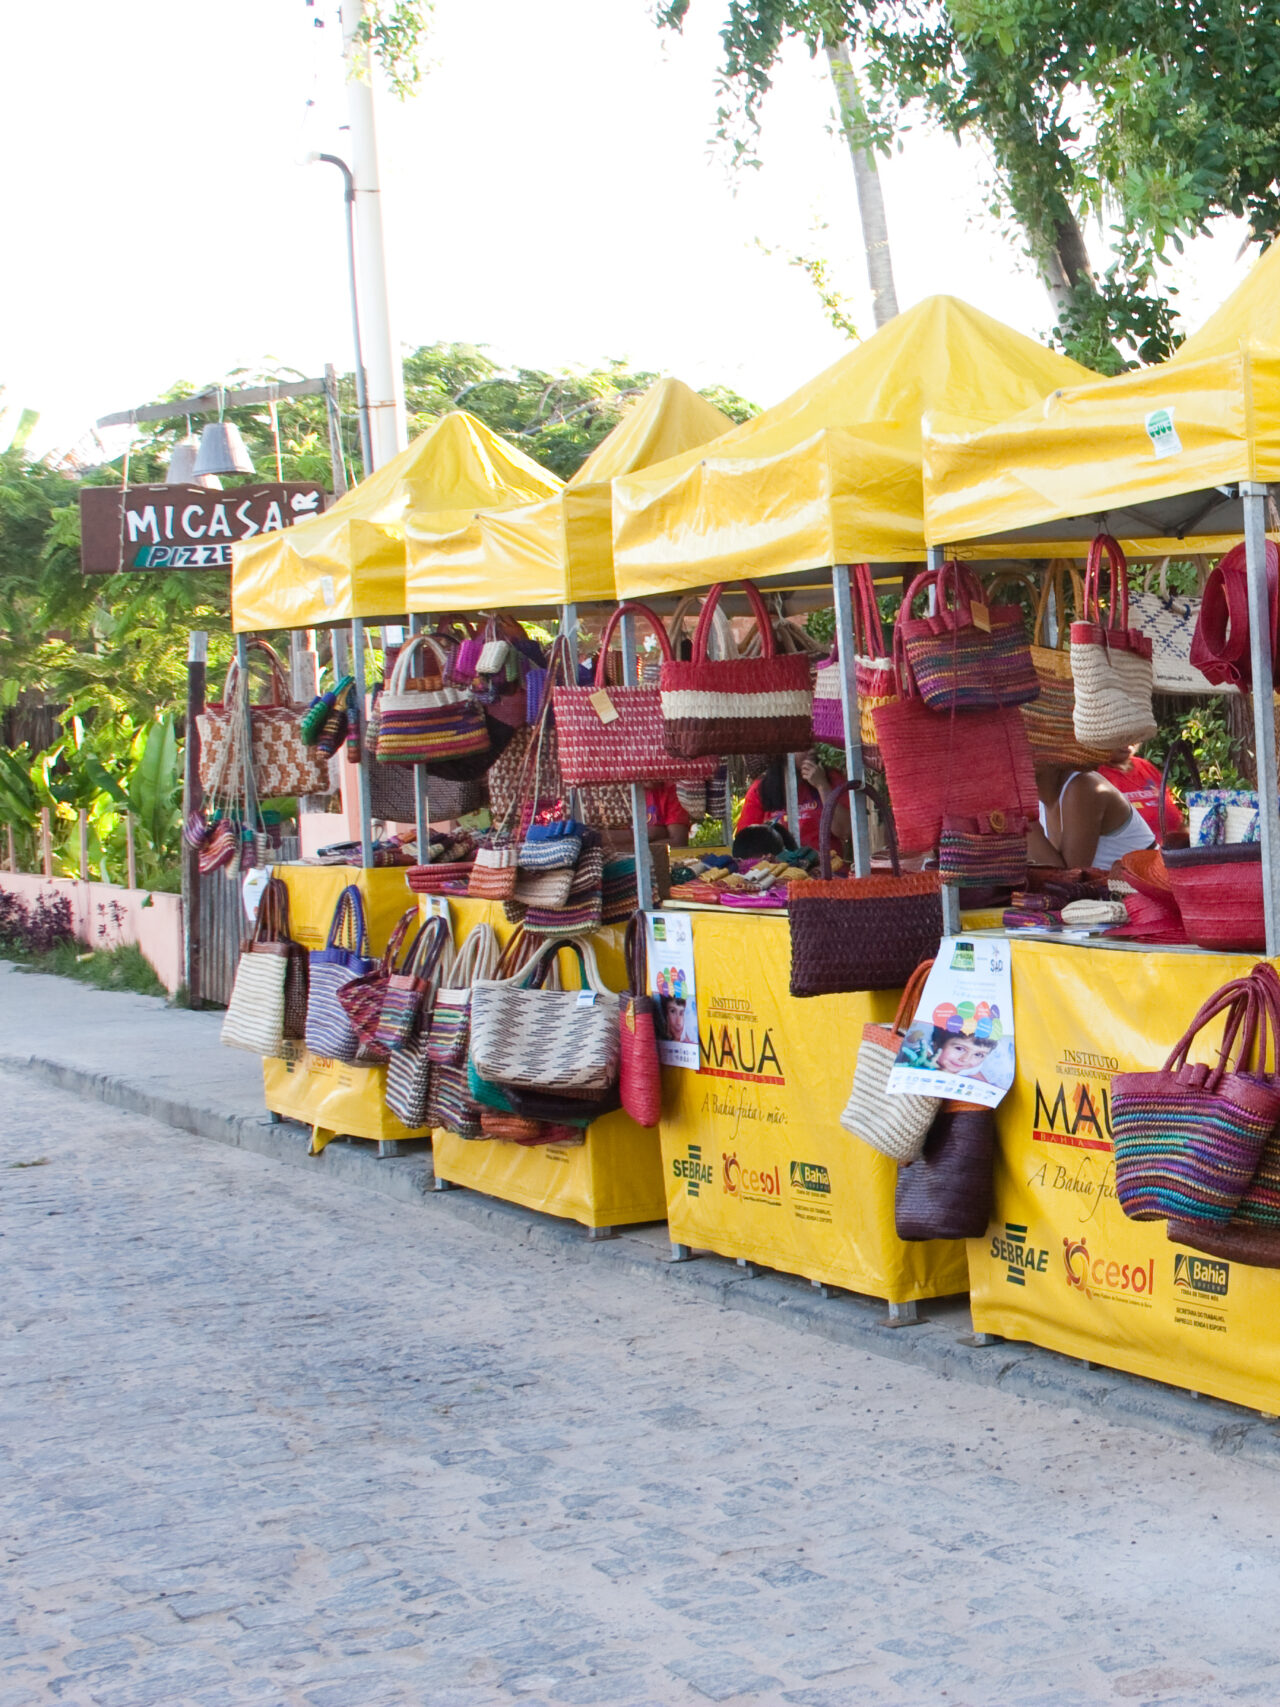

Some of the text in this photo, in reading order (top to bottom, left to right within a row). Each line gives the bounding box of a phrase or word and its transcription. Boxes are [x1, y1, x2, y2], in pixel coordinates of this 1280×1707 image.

[1063, 1049, 1119, 1070] INSTITUTO
[673, 1159, 713, 1184] SEBRAE
[741, 1165, 781, 1196] cesol
[804, 1166, 829, 1185] Bahia
[1027, 1163, 1048, 1187] A
[1053, 1156, 1095, 1196] Bahia
[990, 1237, 1049, 1273] SEBRAE
[1091, 1258, 1154, 1296] cesol
[1193, 1261, 1226, 1286] Bahia
